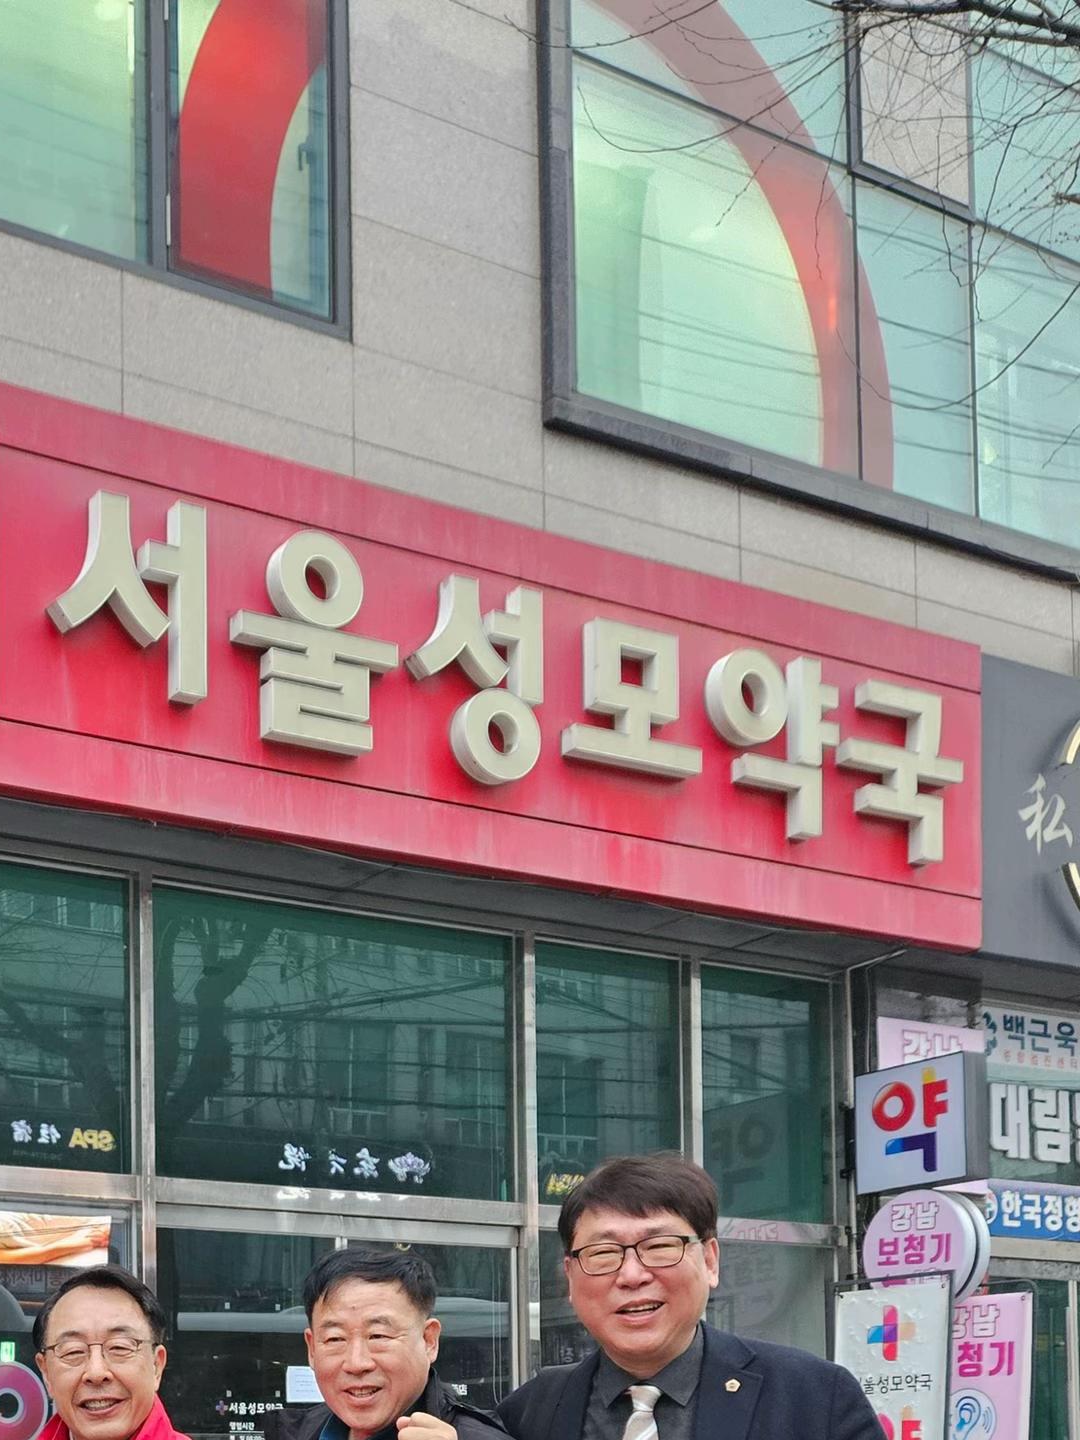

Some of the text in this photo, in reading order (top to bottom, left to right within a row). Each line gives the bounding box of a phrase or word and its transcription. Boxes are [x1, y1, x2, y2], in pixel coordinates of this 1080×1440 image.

[46, 490, 964, 868] 서울성모약국
[1018, 773, 1073, 856] 私
[1003, 1013, 1078, 1056] 백근욱
[871, 1066, 949, 1172] 약
[890, 1200, 940, 1233] 강남
[877, 1232, 952, 1267] 보청기
[957, 1341, 1015, 1378] 청기
[859, 1373, 933, 1395] 울성모약국
